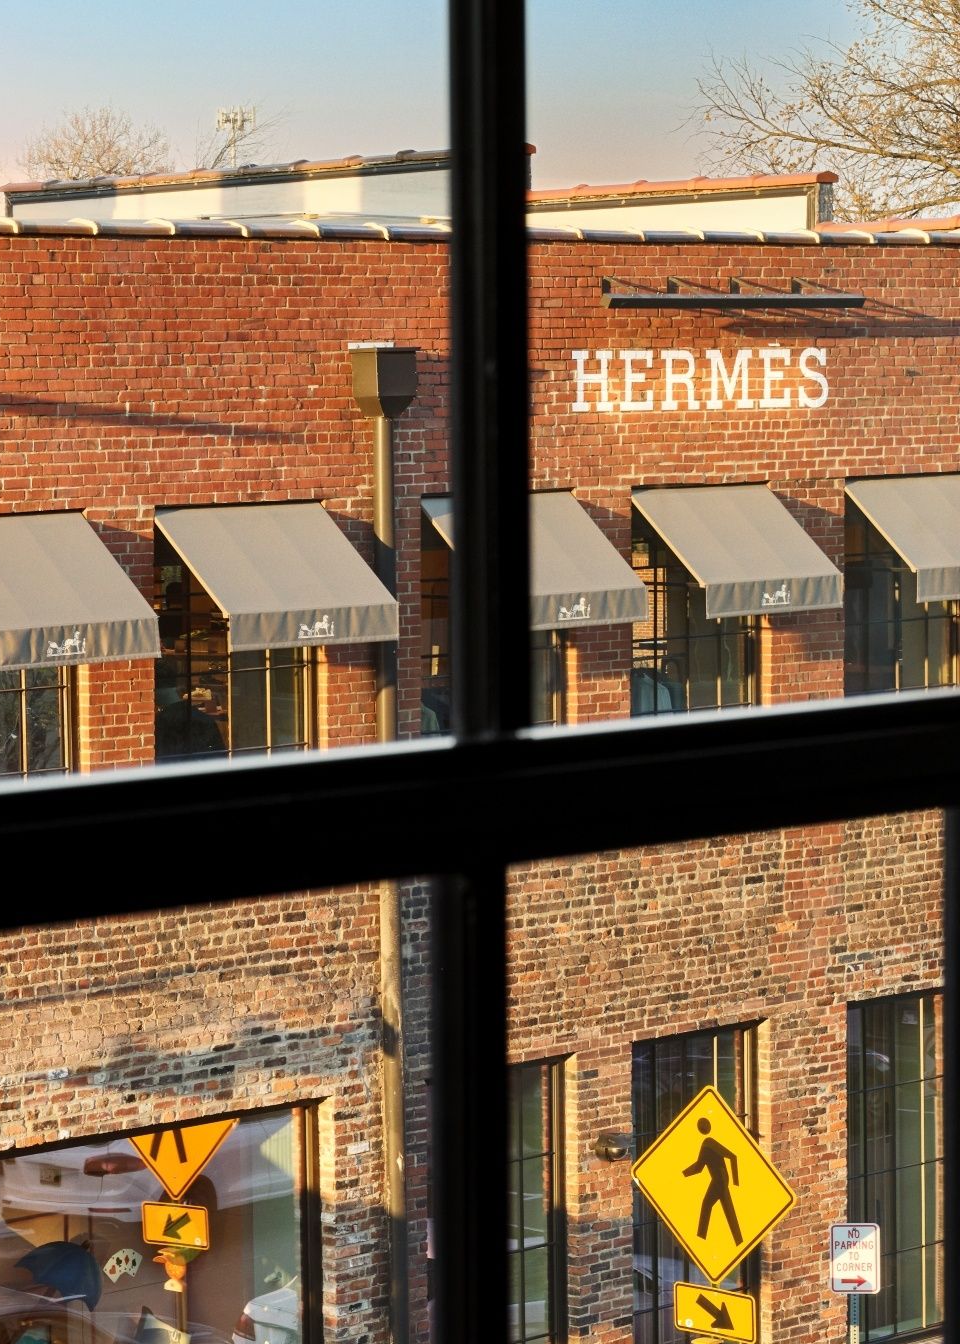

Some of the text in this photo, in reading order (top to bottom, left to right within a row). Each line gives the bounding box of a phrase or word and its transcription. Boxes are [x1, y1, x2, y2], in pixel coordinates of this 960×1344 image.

[848, 1230, 860, 1239] NO
[835, 1241, 874, 1250] PARKING
[849, 1252, 860, 1260] TO
[837, 1263, 873, 1271] CORNER
